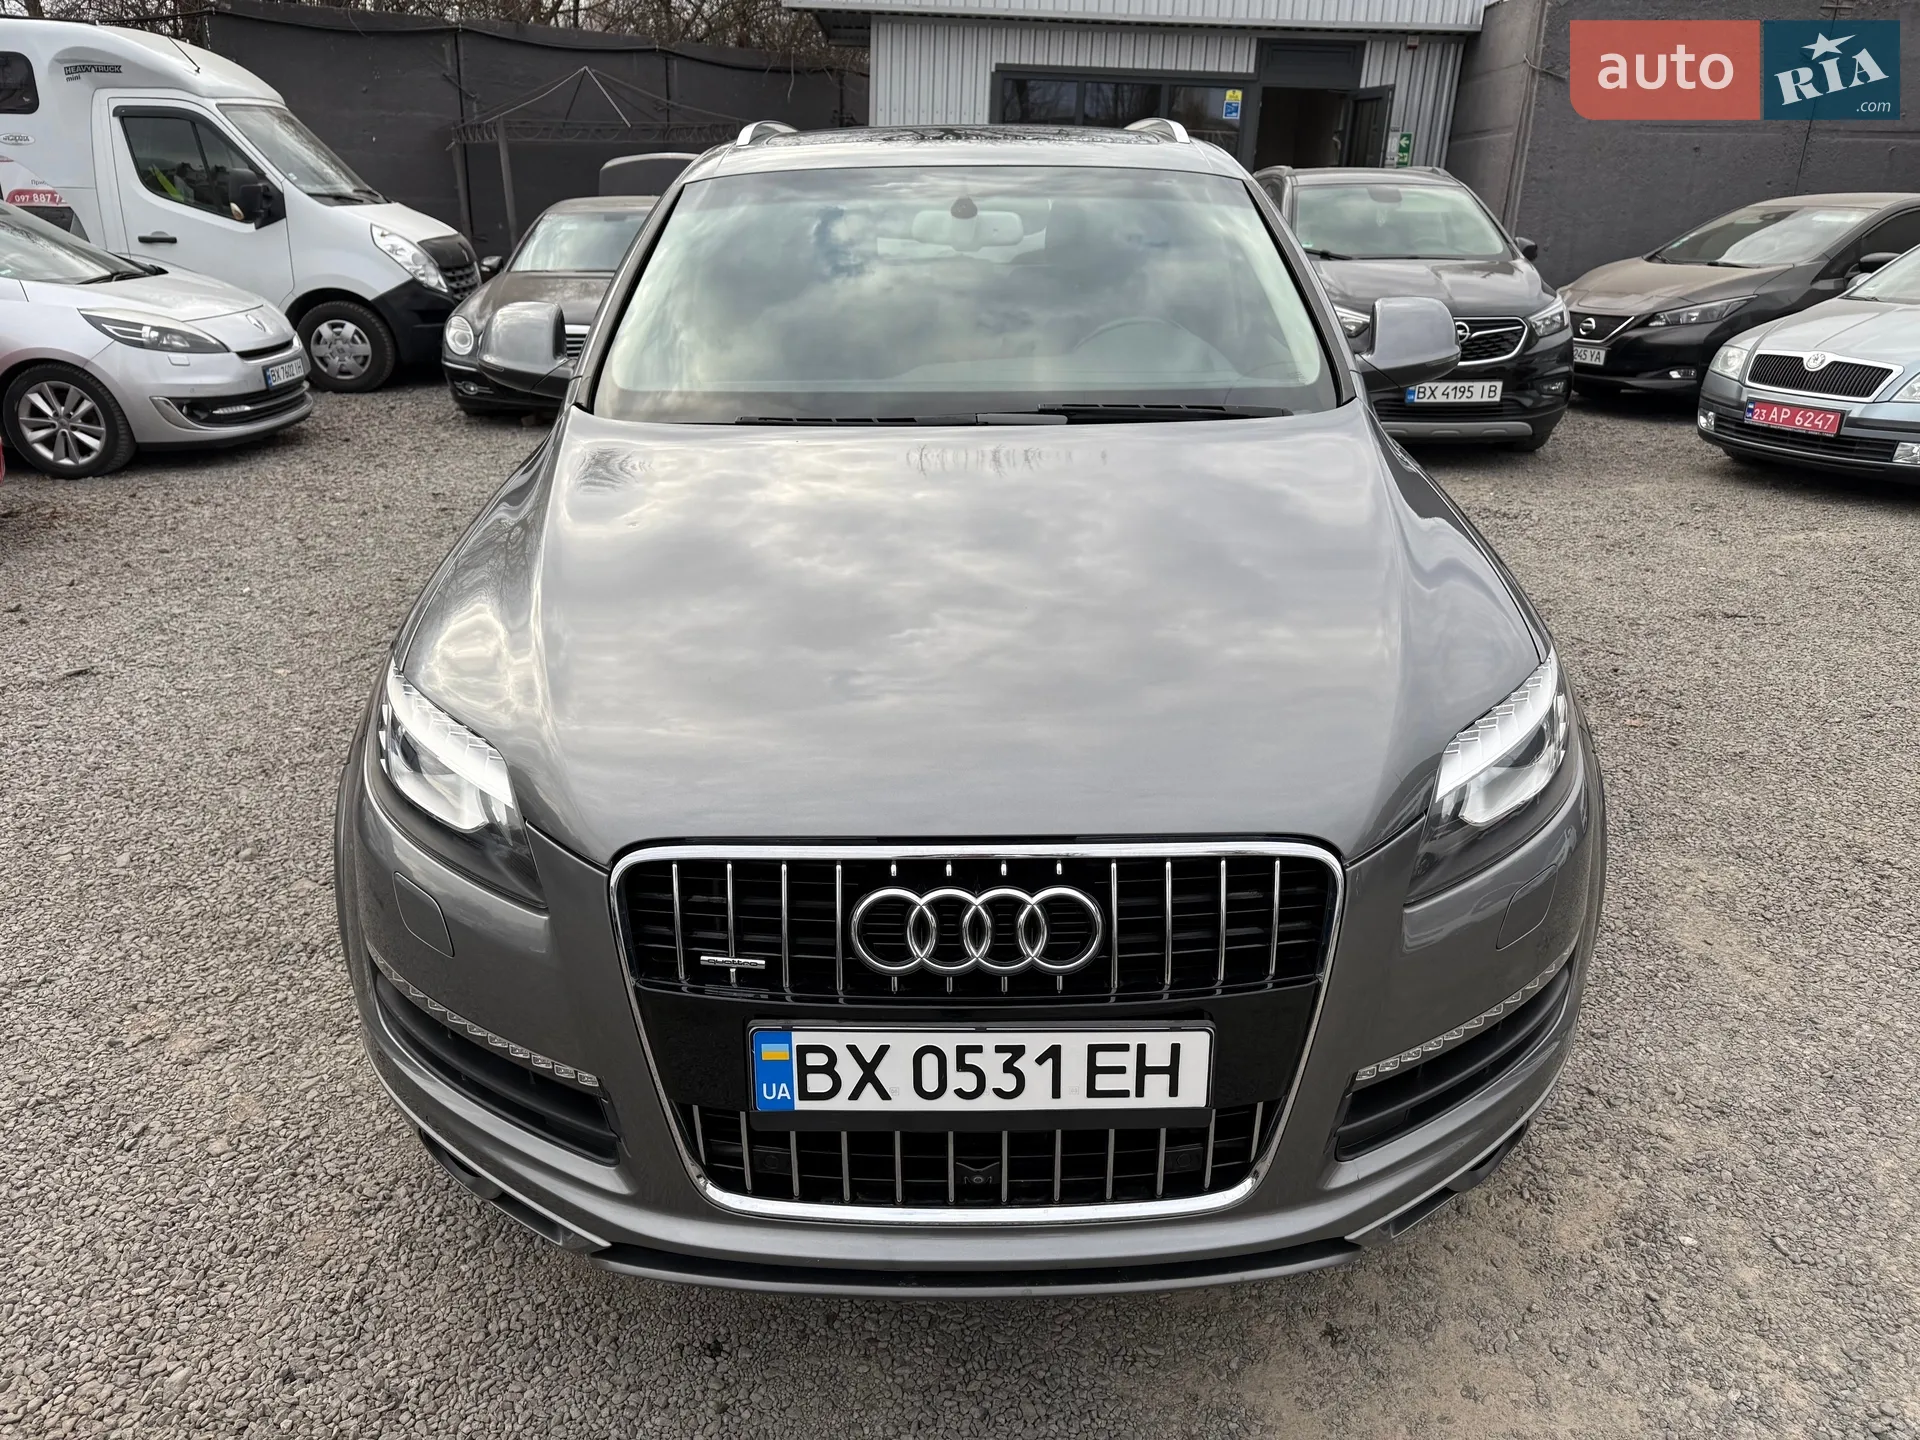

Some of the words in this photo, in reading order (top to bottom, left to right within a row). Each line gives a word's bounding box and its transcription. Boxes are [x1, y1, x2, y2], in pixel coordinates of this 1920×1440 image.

[65, 65, 92, 74] HEAVY
[94, 65, 120, 73] TRUCK
[65, 74, 81, 82] mini
[14, 194, 30, 202] 097
[32, 193, 52, 203] 887
[1416, 385, 1438, 400] BX
[1441, 385, 1474, 400] 4195
[1480, 384, 1498, 399] IB
[1753, 408, 1767, 421] 23
[1769, 406, 1791, 423] AP
[1795, 410, 1835, 430] 6247
[763, 1082, 791, 1100] UA
[796, 1043, 893, 1101] BX
[911, 1043, 1062, 1101] 0531
[1086, 1042, 1181, 1099] EH
